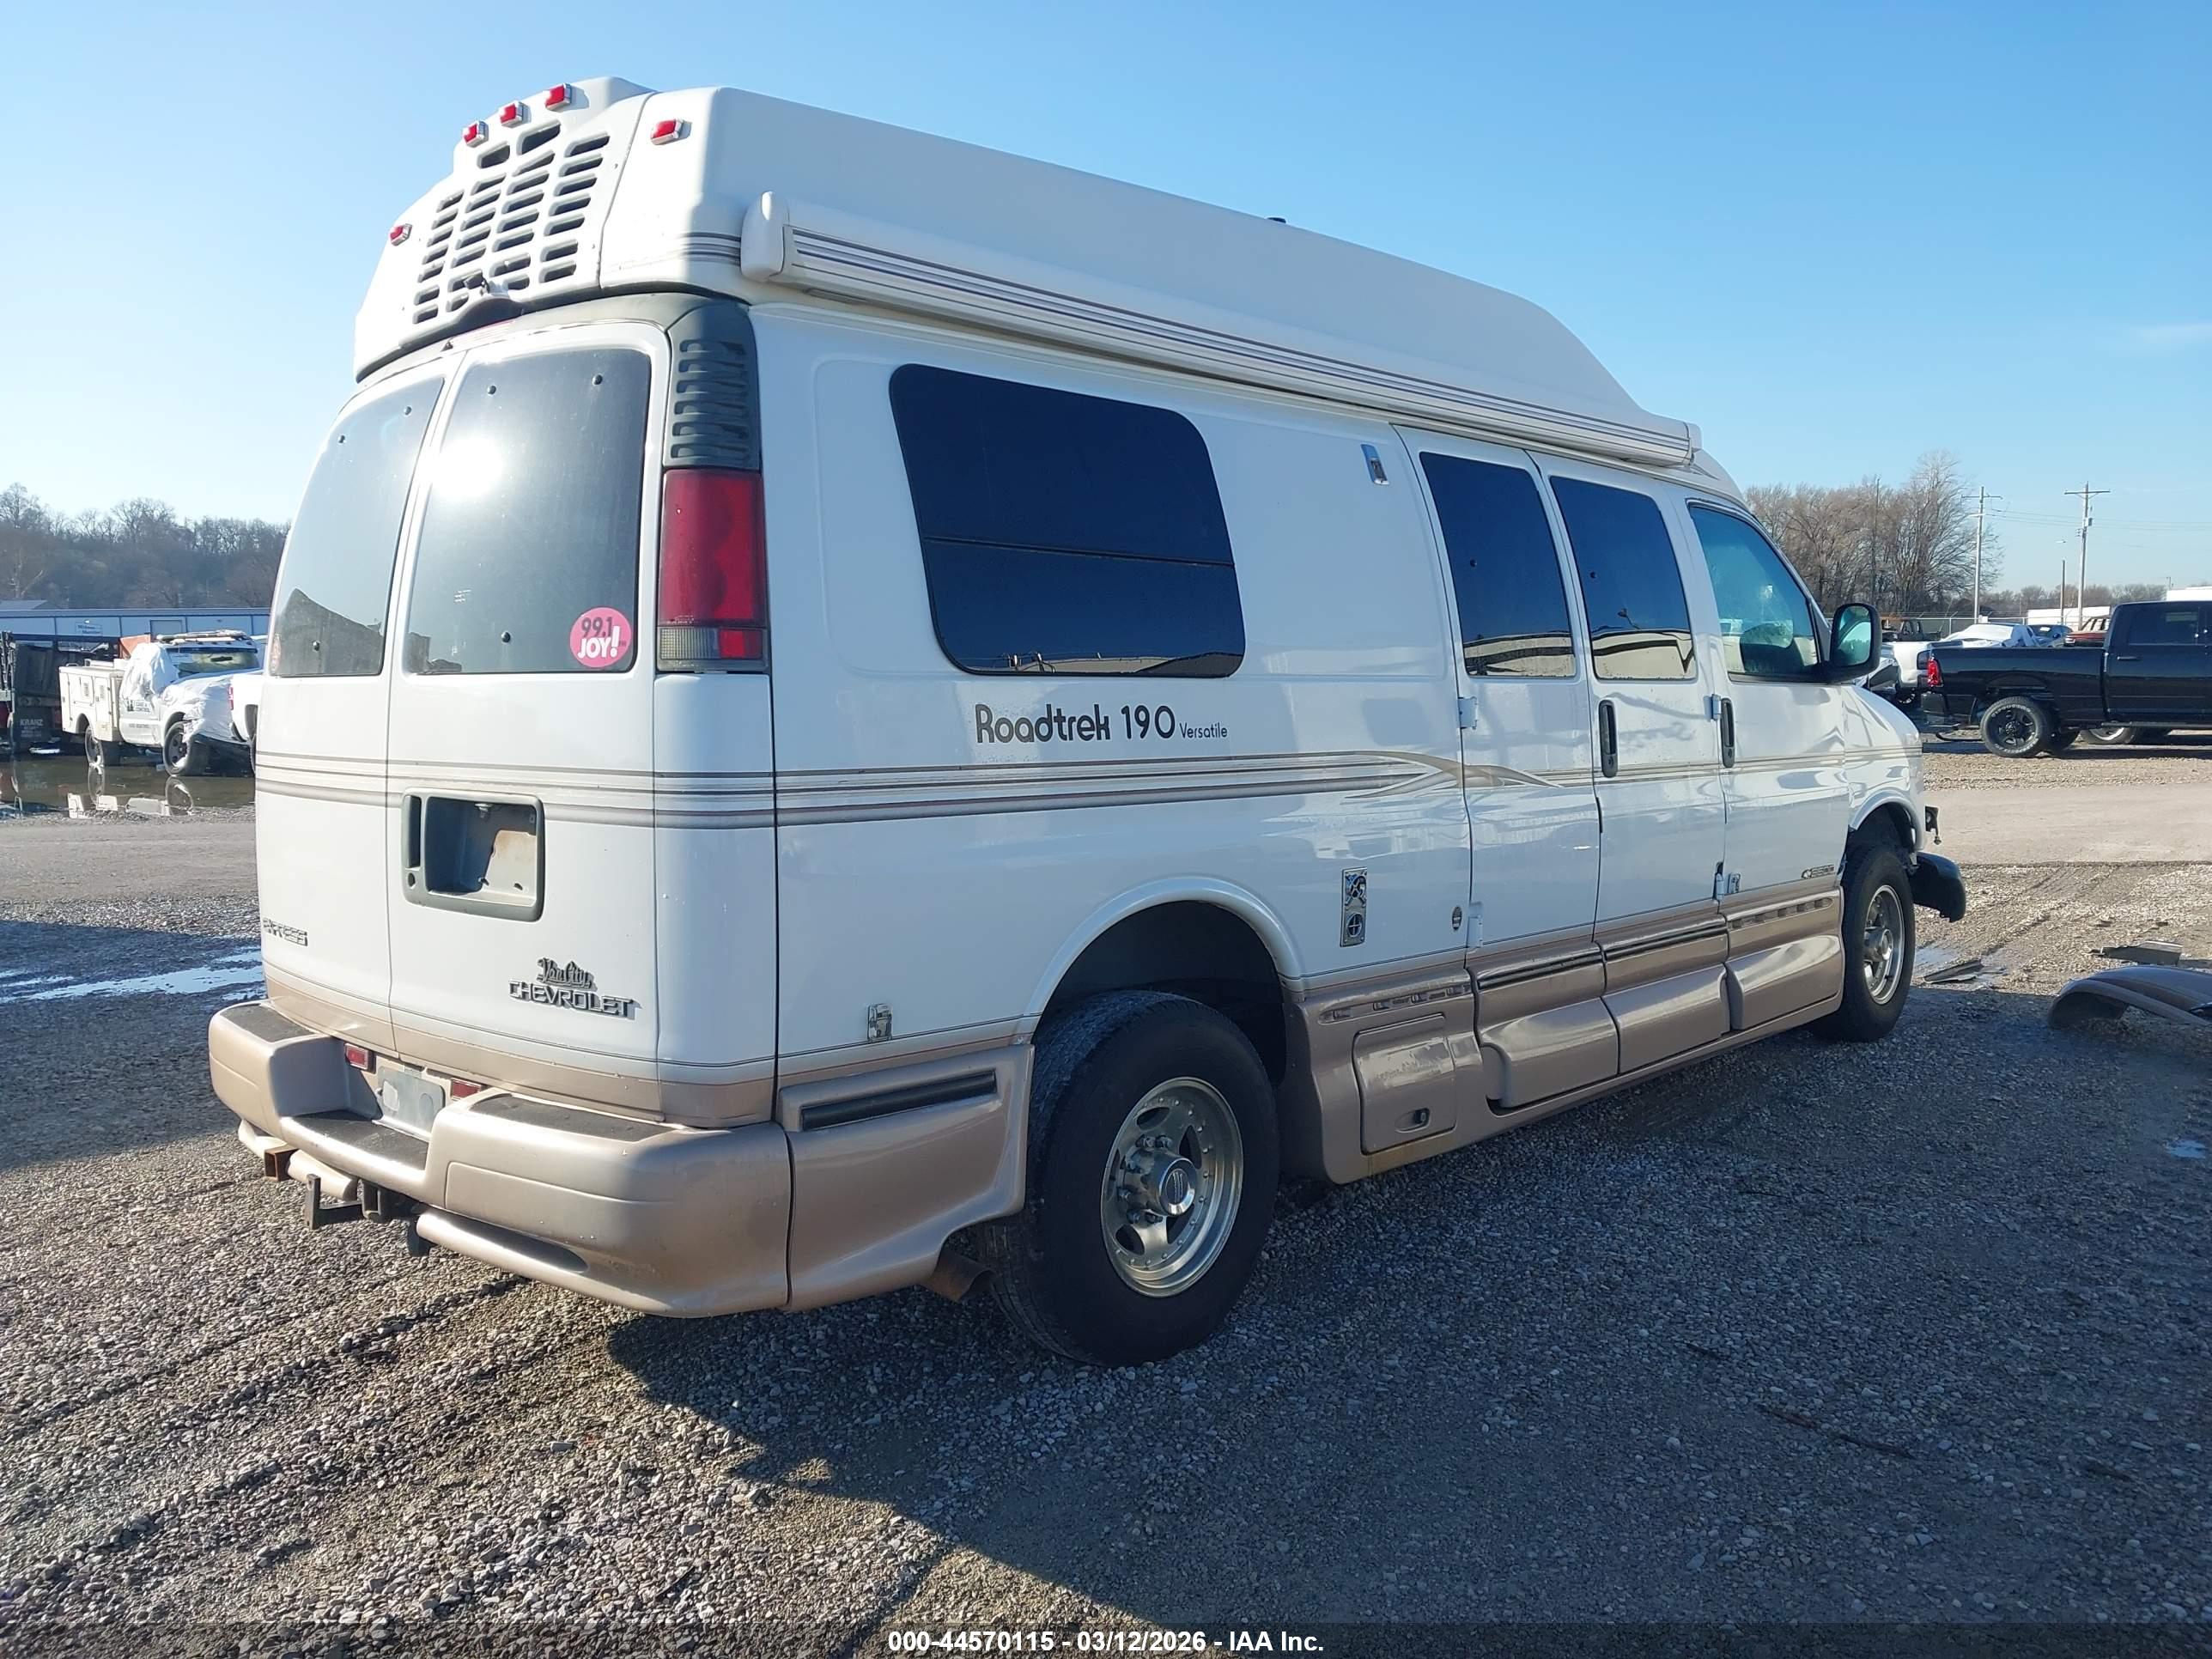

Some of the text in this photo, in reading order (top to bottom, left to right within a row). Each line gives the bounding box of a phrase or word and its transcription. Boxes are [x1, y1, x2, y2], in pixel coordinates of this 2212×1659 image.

[577, 625, 621, 659] JOY!
[581, 617, 612, 637] 99.1
[975, 703, 1228, 743] Roadtrek 190 Versatile
[508, 980, 635, 1018] CHEVROLET
